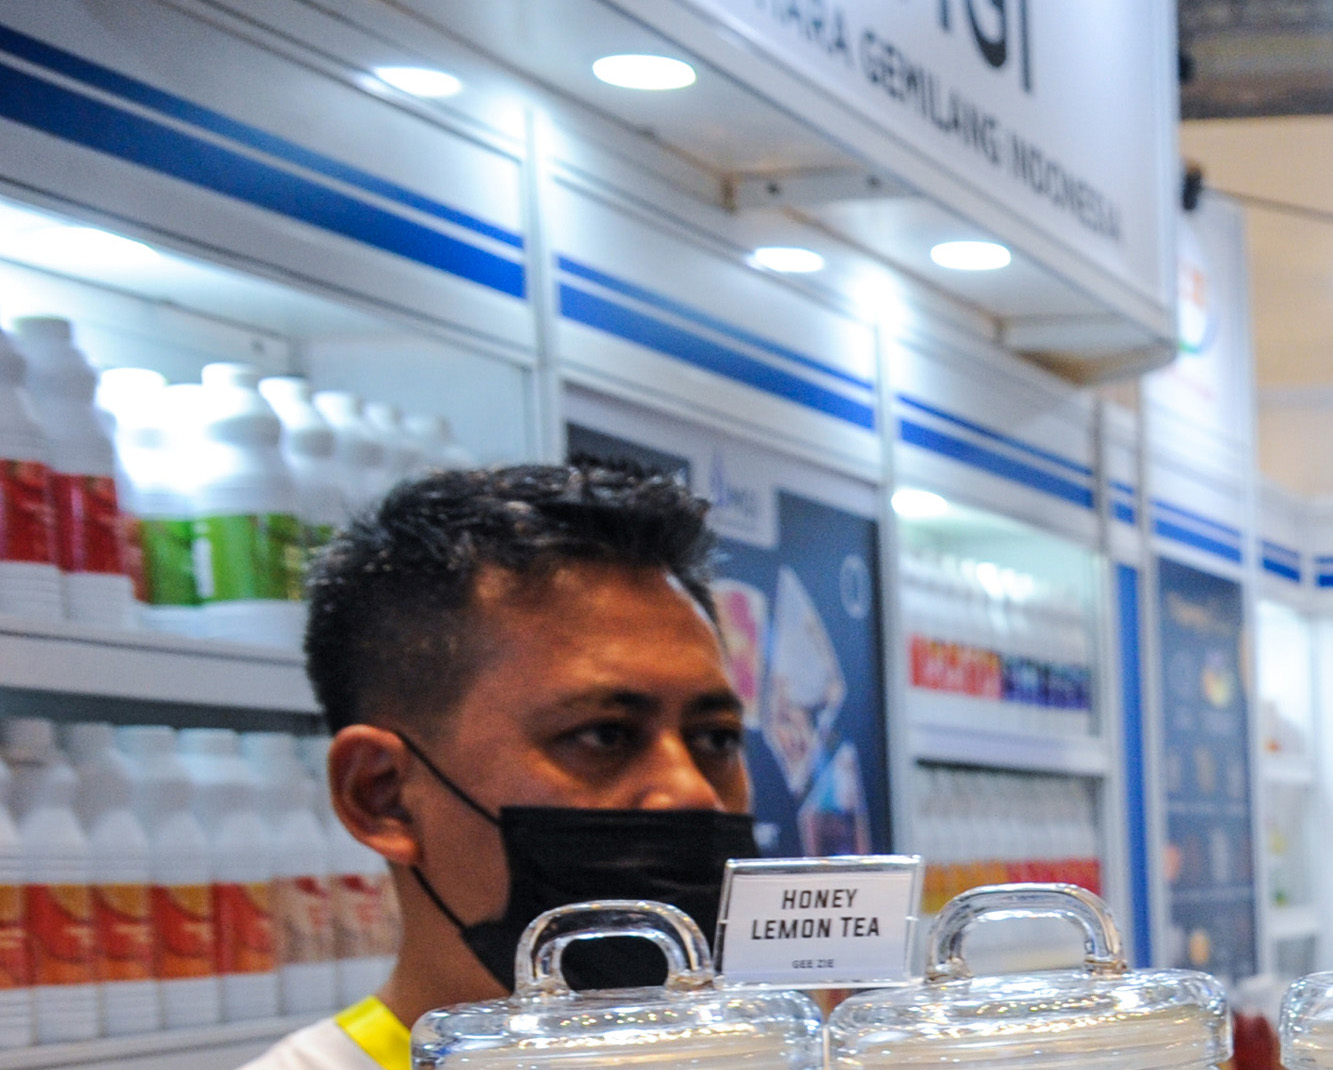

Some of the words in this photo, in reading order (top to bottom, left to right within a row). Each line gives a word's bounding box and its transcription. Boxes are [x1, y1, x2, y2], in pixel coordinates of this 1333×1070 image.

[861, 30, 1000, 165] GEMILANG
[782, 888, 858, 910] HONEY
[751, 918, 831, 940] LEMON
[840, 916, 880, 938] TEA
[792, 959, 813, 969] GEE
[817, 958, 834, 968] ZIE
